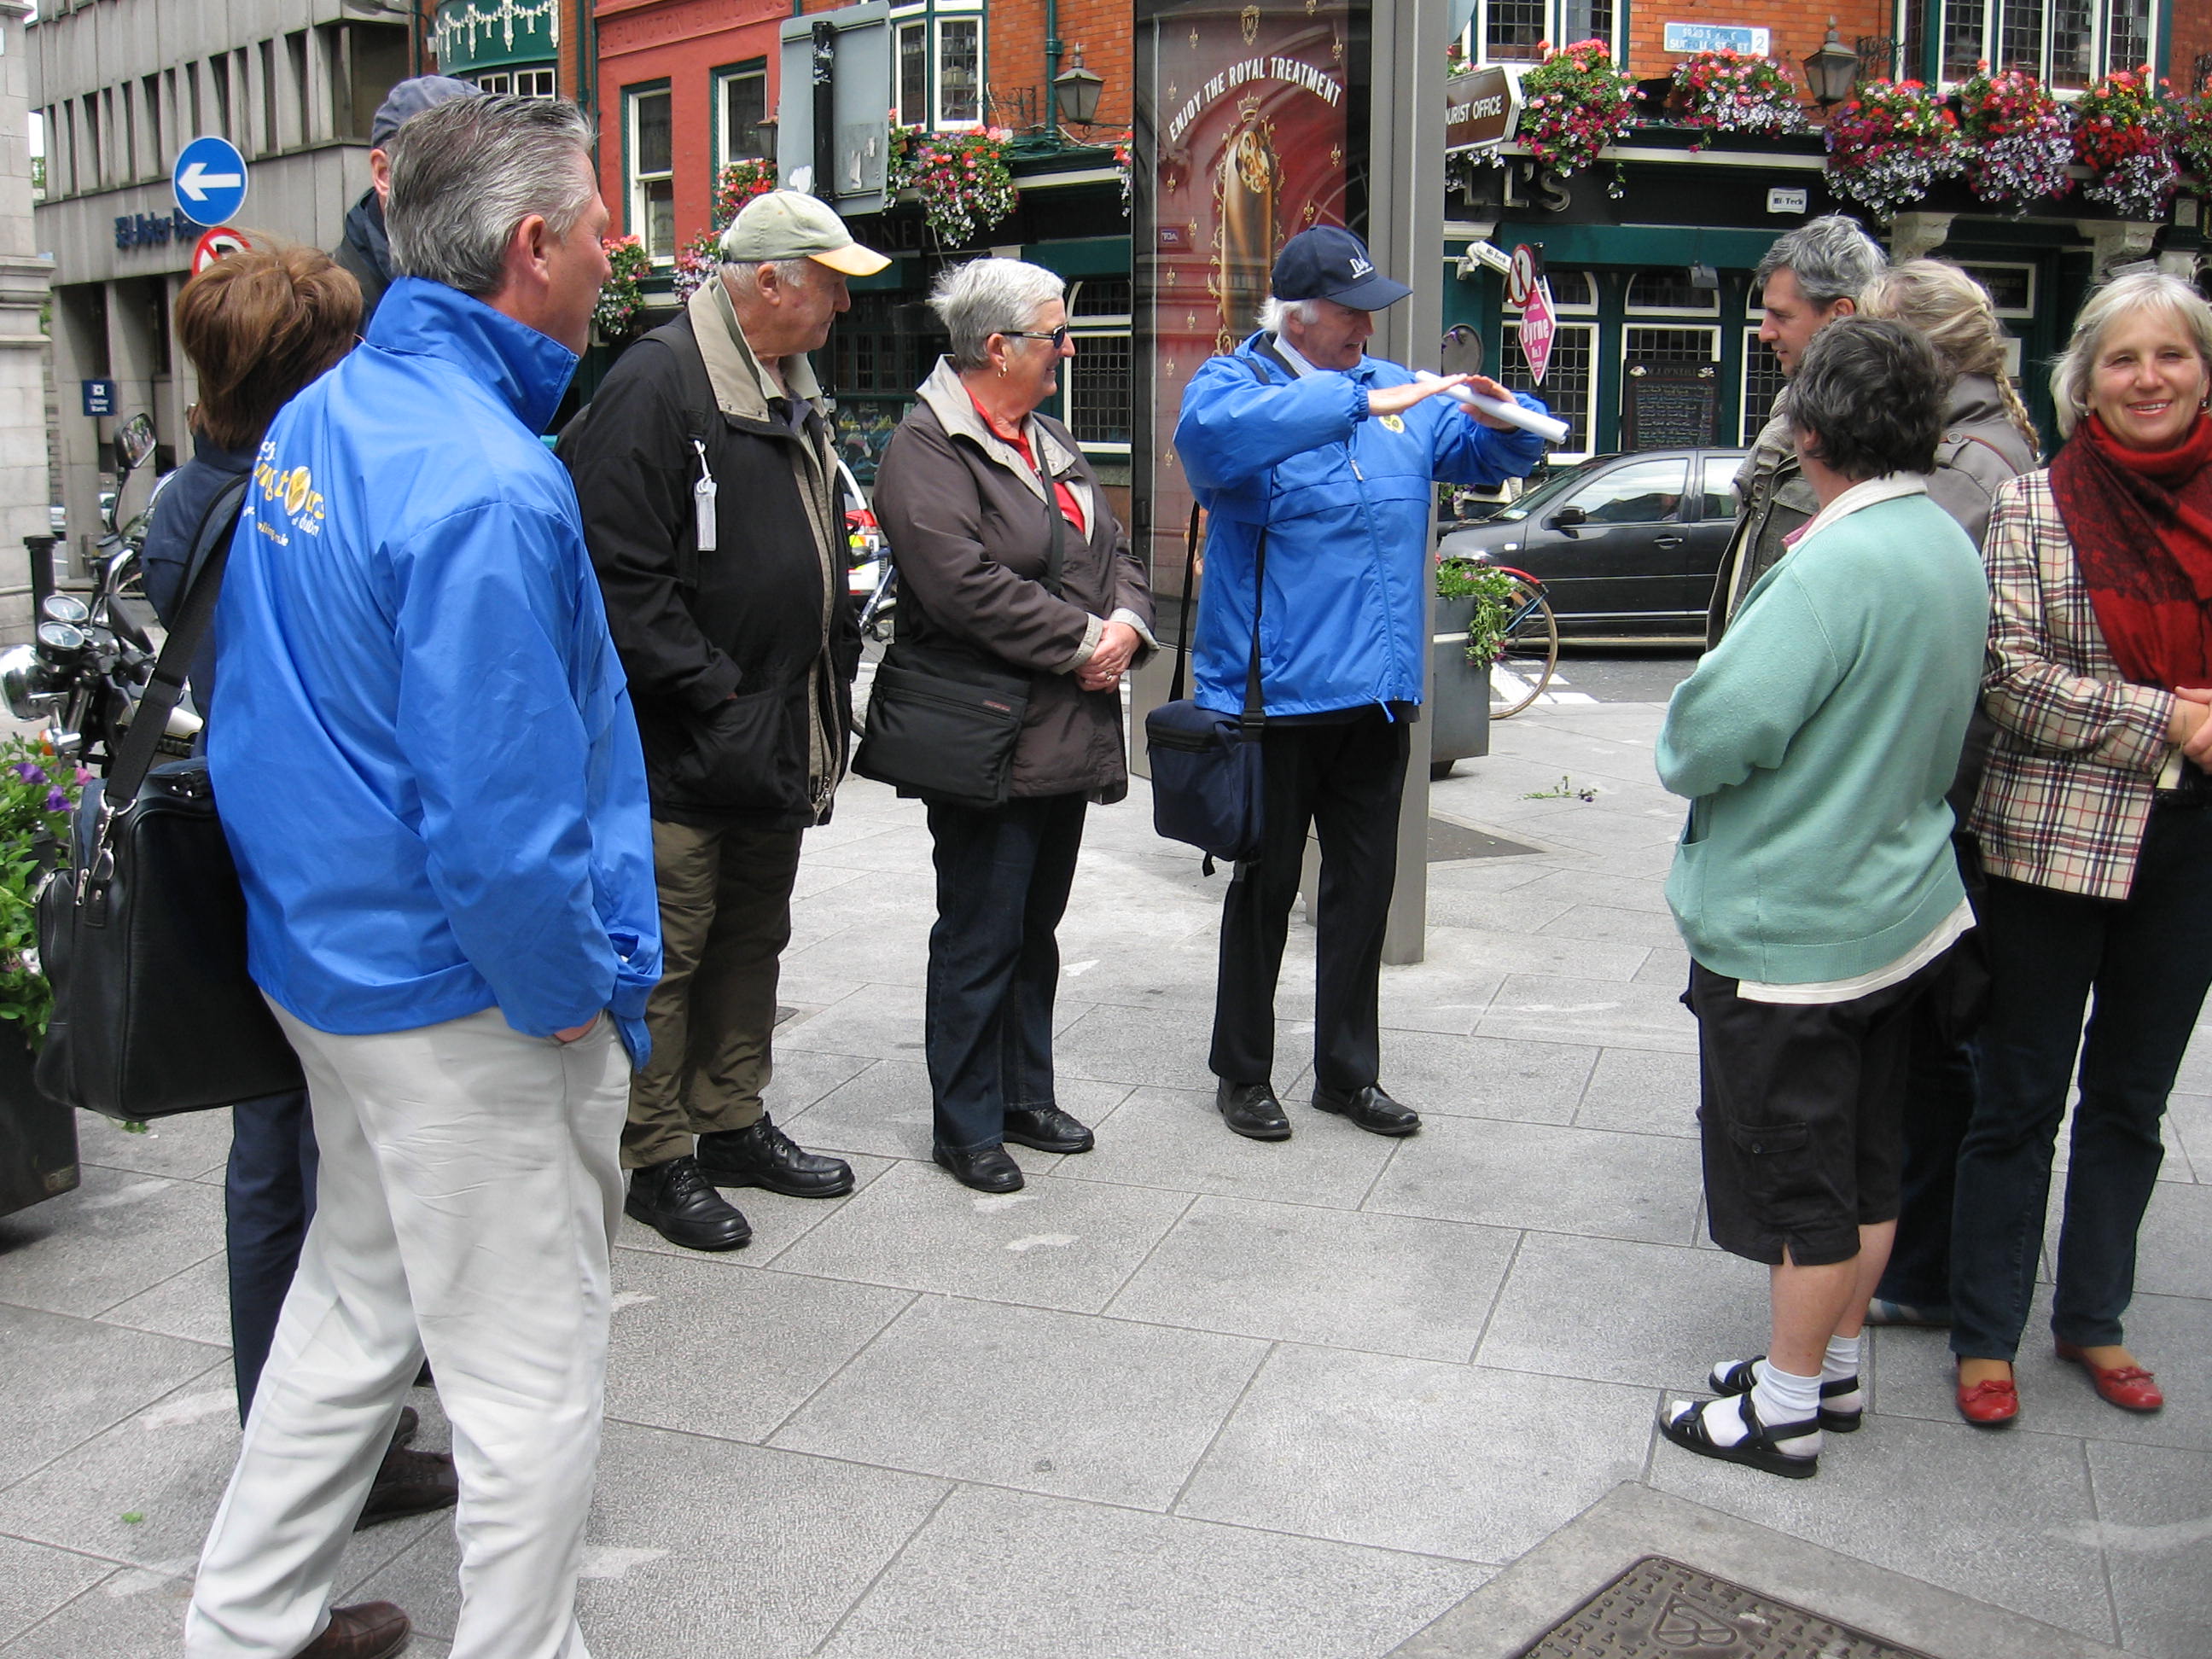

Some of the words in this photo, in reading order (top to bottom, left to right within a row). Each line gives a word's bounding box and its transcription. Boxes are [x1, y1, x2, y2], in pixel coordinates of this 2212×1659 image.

[1755, 35, 1765, 49] 2
[1168, 90, 1202, 143] ENJOY
[1203, 72, 1226, 102] THE
[1229, 57, 1266, 88] ROYAL
[1270, 56, 1342, 108] TREATMENT
[1446, 102, 1470, 125] URIST
[1473, 95, 1503, 119] OFFICE
[1522, 317, 1551, 346] Byrne
